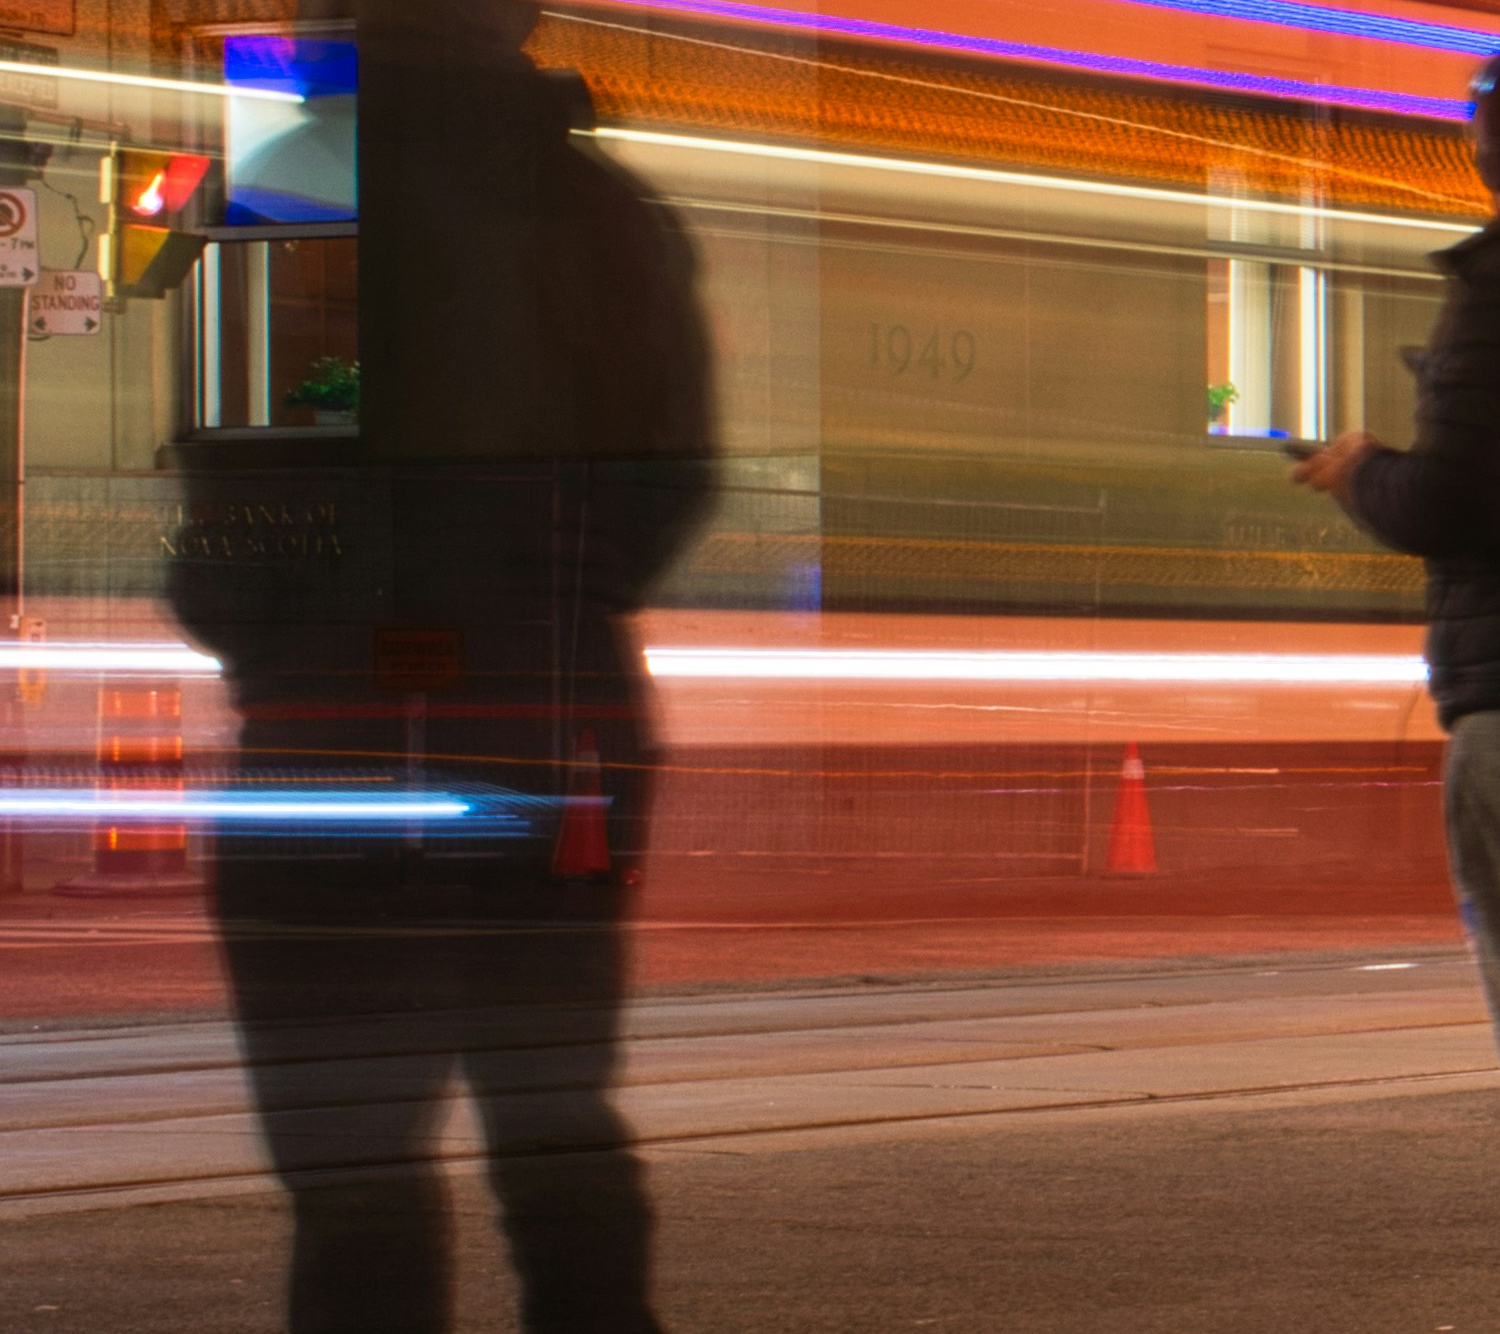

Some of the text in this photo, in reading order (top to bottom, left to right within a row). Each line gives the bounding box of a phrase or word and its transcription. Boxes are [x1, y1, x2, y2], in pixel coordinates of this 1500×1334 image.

[54, 275, 77, 291] NO
[31, 294, 100, 311] STANDING
[868, 322, 976, 385] 1949
